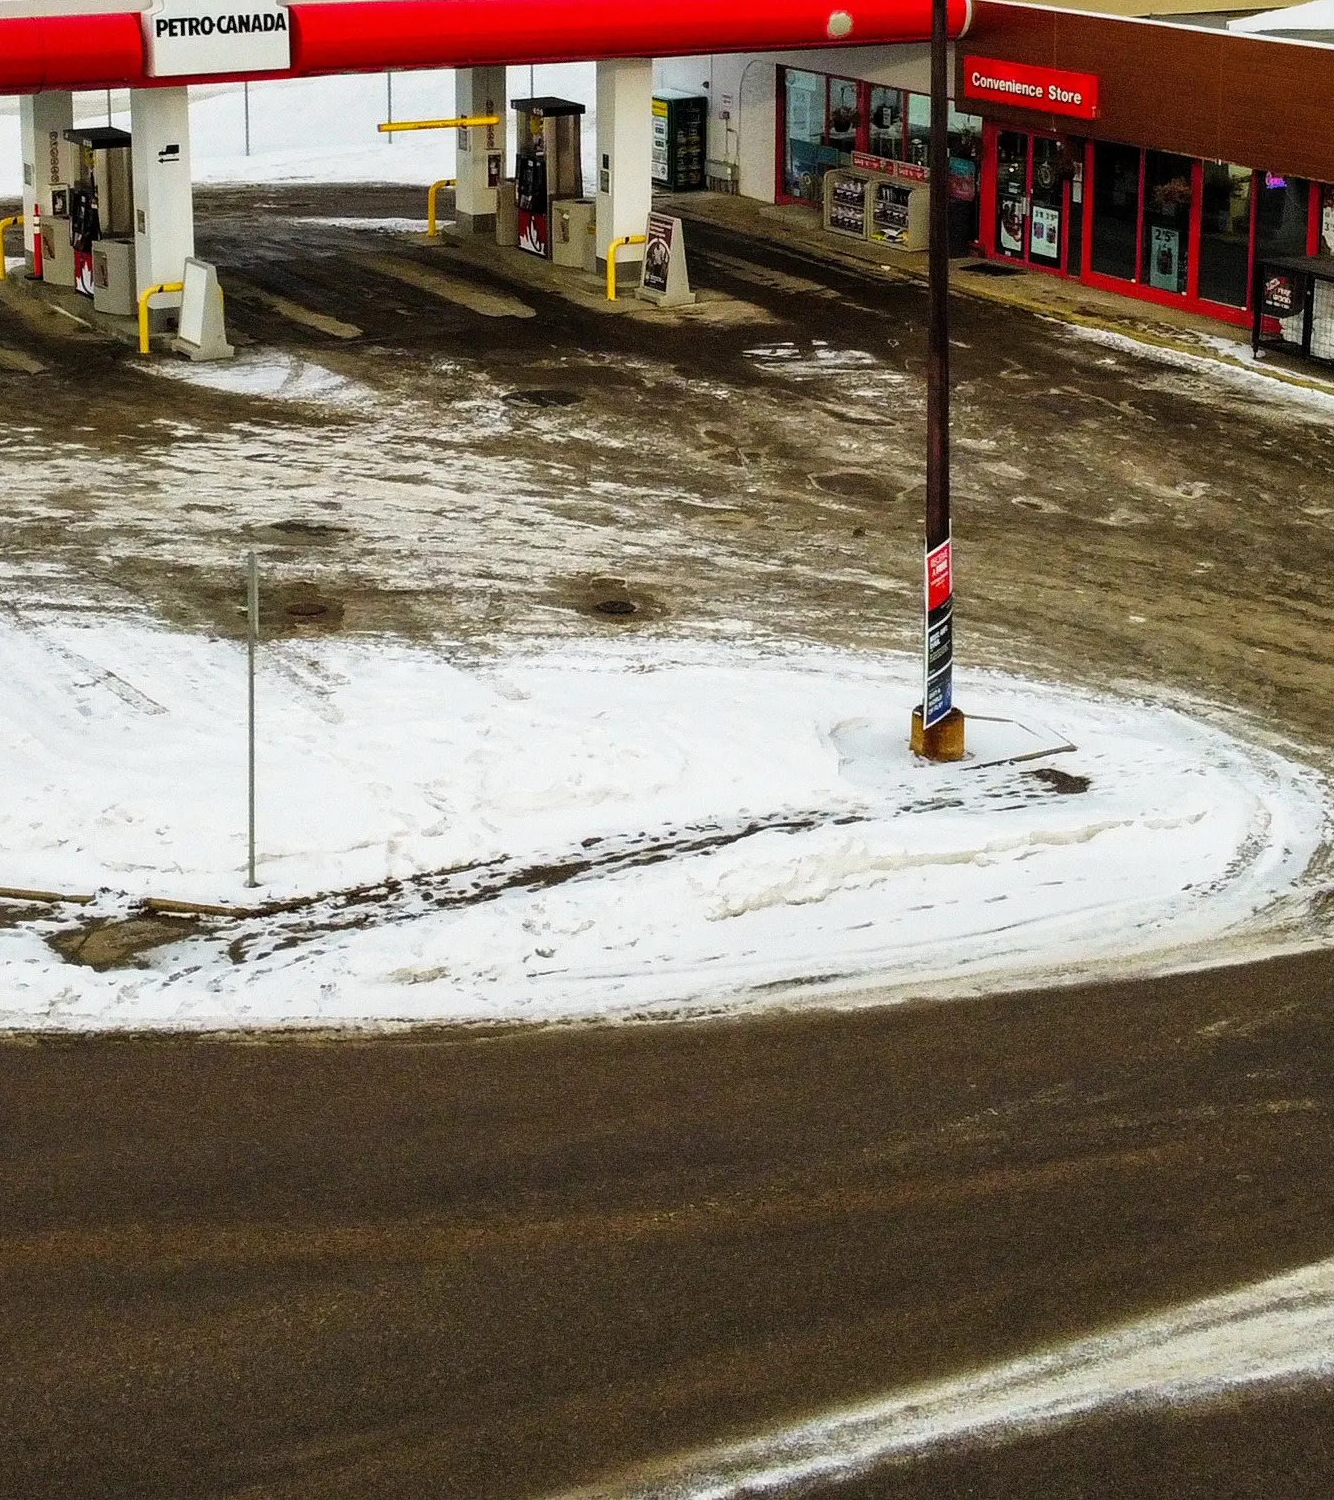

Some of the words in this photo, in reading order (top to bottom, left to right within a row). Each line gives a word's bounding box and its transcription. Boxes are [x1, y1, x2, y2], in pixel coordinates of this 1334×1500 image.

[155, 12, 287, 38] PETRO-CANADA
[971, 72, 1044, 98] Convenience
[1048, 85, 1082, 105] Store
